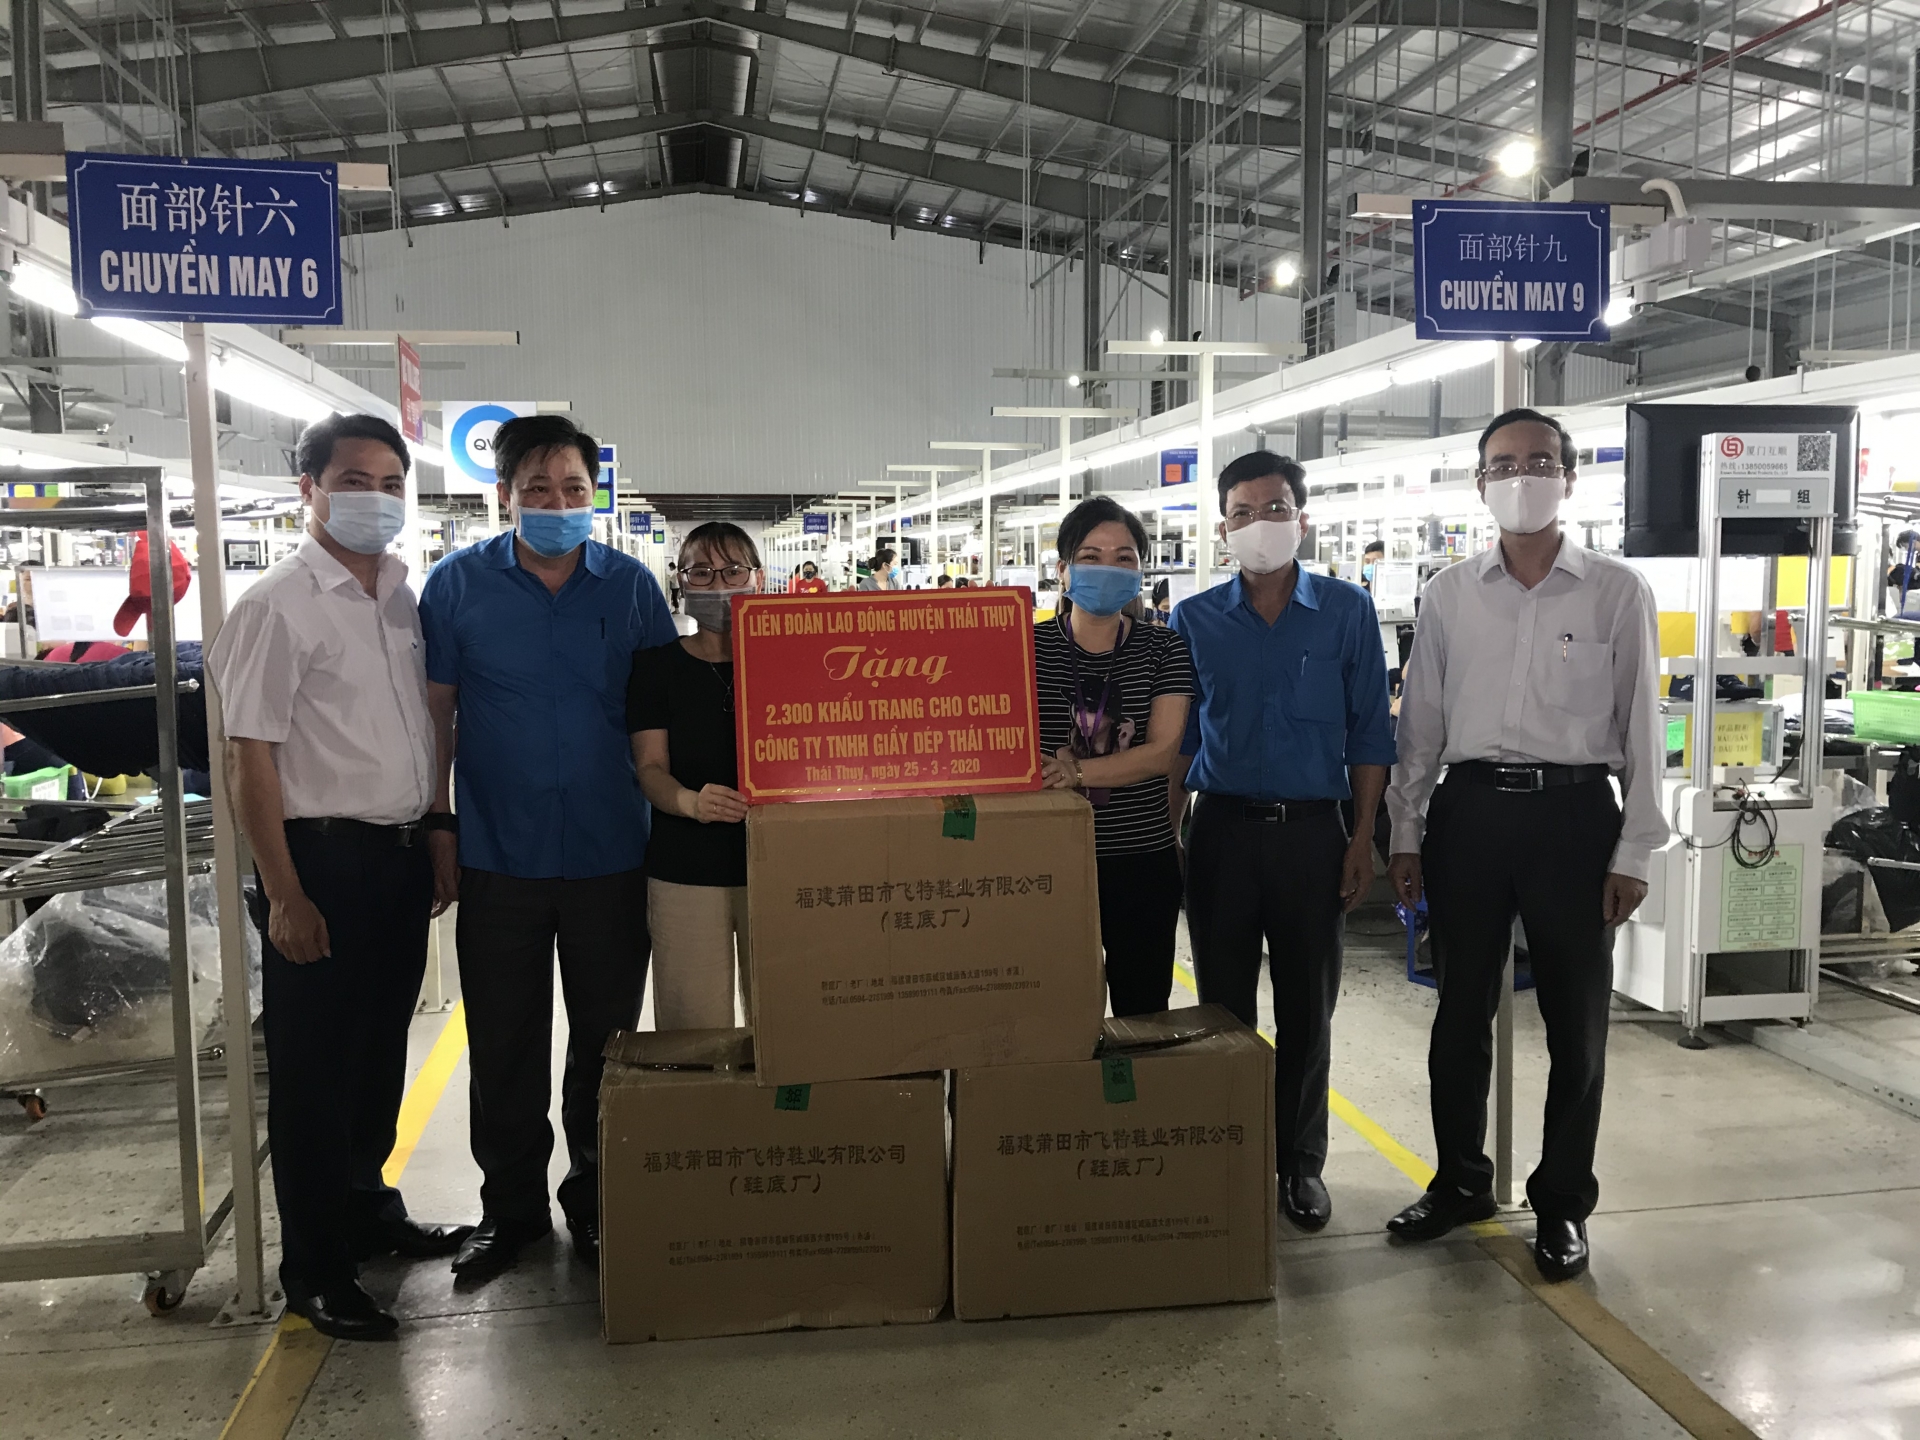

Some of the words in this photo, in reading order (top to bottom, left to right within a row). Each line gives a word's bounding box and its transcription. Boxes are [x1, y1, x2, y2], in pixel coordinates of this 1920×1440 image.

[116, 181, 298, 237] 面部针六
[1458, 232, 1568, 265] 面部针九
[100, 238, 221, 297] CHUYỀN
[230, 257, 294, 298] MAY
[302, 258, 318, 298] 6
[1440, 270, 1519, 312] CHUYỀN
[1524, 280, 1566, 312] MAY
[1572, 280, 1586, 312] 9
[1737, 488, 1751, 504] 针
[1797, 489, 1811, 504] 组
[750, 610, 781, 637] LIÊN
[784, 608, 824, 635] ĐOÀN
[827, 610, 853, 634] LAO
[857, 606, 896, 637] ĐỘNG
[899, 603, 945, 634] HUYỆN
[947, 602, 978, 630] THÁI
[981, 605, 1016, 632] THỤY
[823, 645, 952, 687] Tặng
[765, 703, 813, 726] 2.300
[817, 692, 864, 723] KHẨU
[868, 698, 924, 721] TRANG
[929, 695, 963, 718] CHO
[967, 693, 1011, 716] CNLĐ
[754, 734, 799, 762] CÔNG
[803, 737, 823, 760] TY
[826, 735, 869, 759] TNHH
[913, 726, 943, 754] DÉP
[948, 724, 983, 753] THÁI
[986, 726, 1025, 755] THỤY
[805, 764, 832, 782] Thái
[871, 763, 901, 780] ngày
[904, 761, 919, 777] 25
[931, 761, 939, 775] 3
[950, 758, 981, 774] 2020
[795, 874, 1053, 909] 福建莆田市飞特鞋业有限公司
[880, 907, 971, 932] (鞋底厂)
[997, 1124, 1245, 1156] 福建莆田市飞特鞋业有限公司
[643, 1144, 906, 1174] 福建莆田市飞特鞋业有限公司
[1076, 1156, 1165, 1180] (鞋底厂)
[729, 1173, 822, 1196] (鞋底厂)
